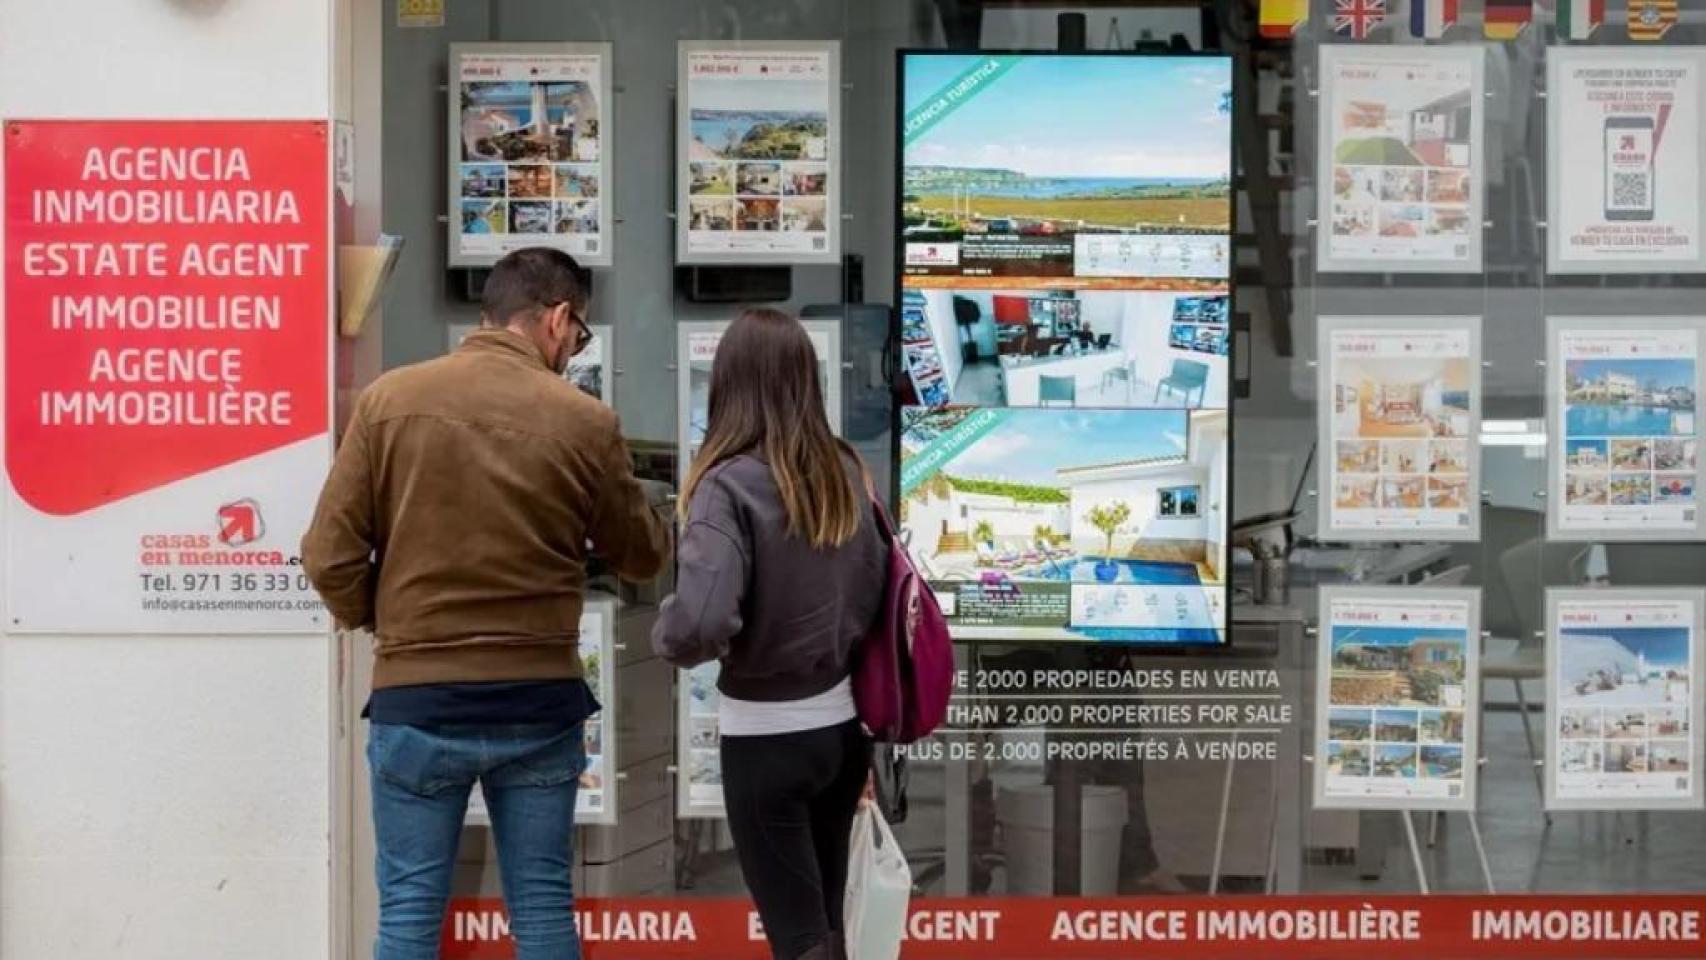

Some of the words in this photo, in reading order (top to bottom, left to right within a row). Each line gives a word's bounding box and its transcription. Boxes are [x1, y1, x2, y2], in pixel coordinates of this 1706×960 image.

[82, 147, 250, 181] AGENCIA
[33, 189, 299, 223] INMOBILIARIA
[24, 243, 167, 276] ESTATE
[180, 243, 309, 276] AGENT
[52, 296, 280, 330] IMMOBILIEN
[90, 349, 241, 382] AGENCE
[41, 384, 290, 425] IMMOBILIÈRE
[140, 534, 211, 549] casas
[140, 551, 172, 566] en
[140, 573, 177, 592] Tel.
[182, 573, 221, 592] 971
[230, 573, 258, 592] 36
[263, 573, 291, 592] 33
[953, 669, 969, 688] E
[976, 670, 1026, 688] 2000
[1034, 670, 1174, 688] PROPIEDADES
[1180, 670, 1207, 688] EN
[1214, 670, 1281, 688] VENTA
[946, 704, 999, 723] THAN
[1006, 704, 1063, 724] 2.000
[1070, 704, 1192, 723] PROPERTIES
[1198, 704, 1239, 723] FOR
[1244, 704, 1292, 723] SALE
[893, 742, 944, 761] PLUS
[950, 742, 976, 761] DE
[984, 741, 1042, 761] 2.000
[1047, 738, 1169, 761] PROPRIÉTÉS
[1175, 738, 1190, 760] À
[1196, 741, 1277, 760] VENDRE
[899, 911, 1000, 941] GENT
[1051, 911, 1187, 940] AGENCE
[1197, 904, 1420, 940] IMMOBILIÈRE
[1472, 911, 1699, 940] IMMOBILIARE
